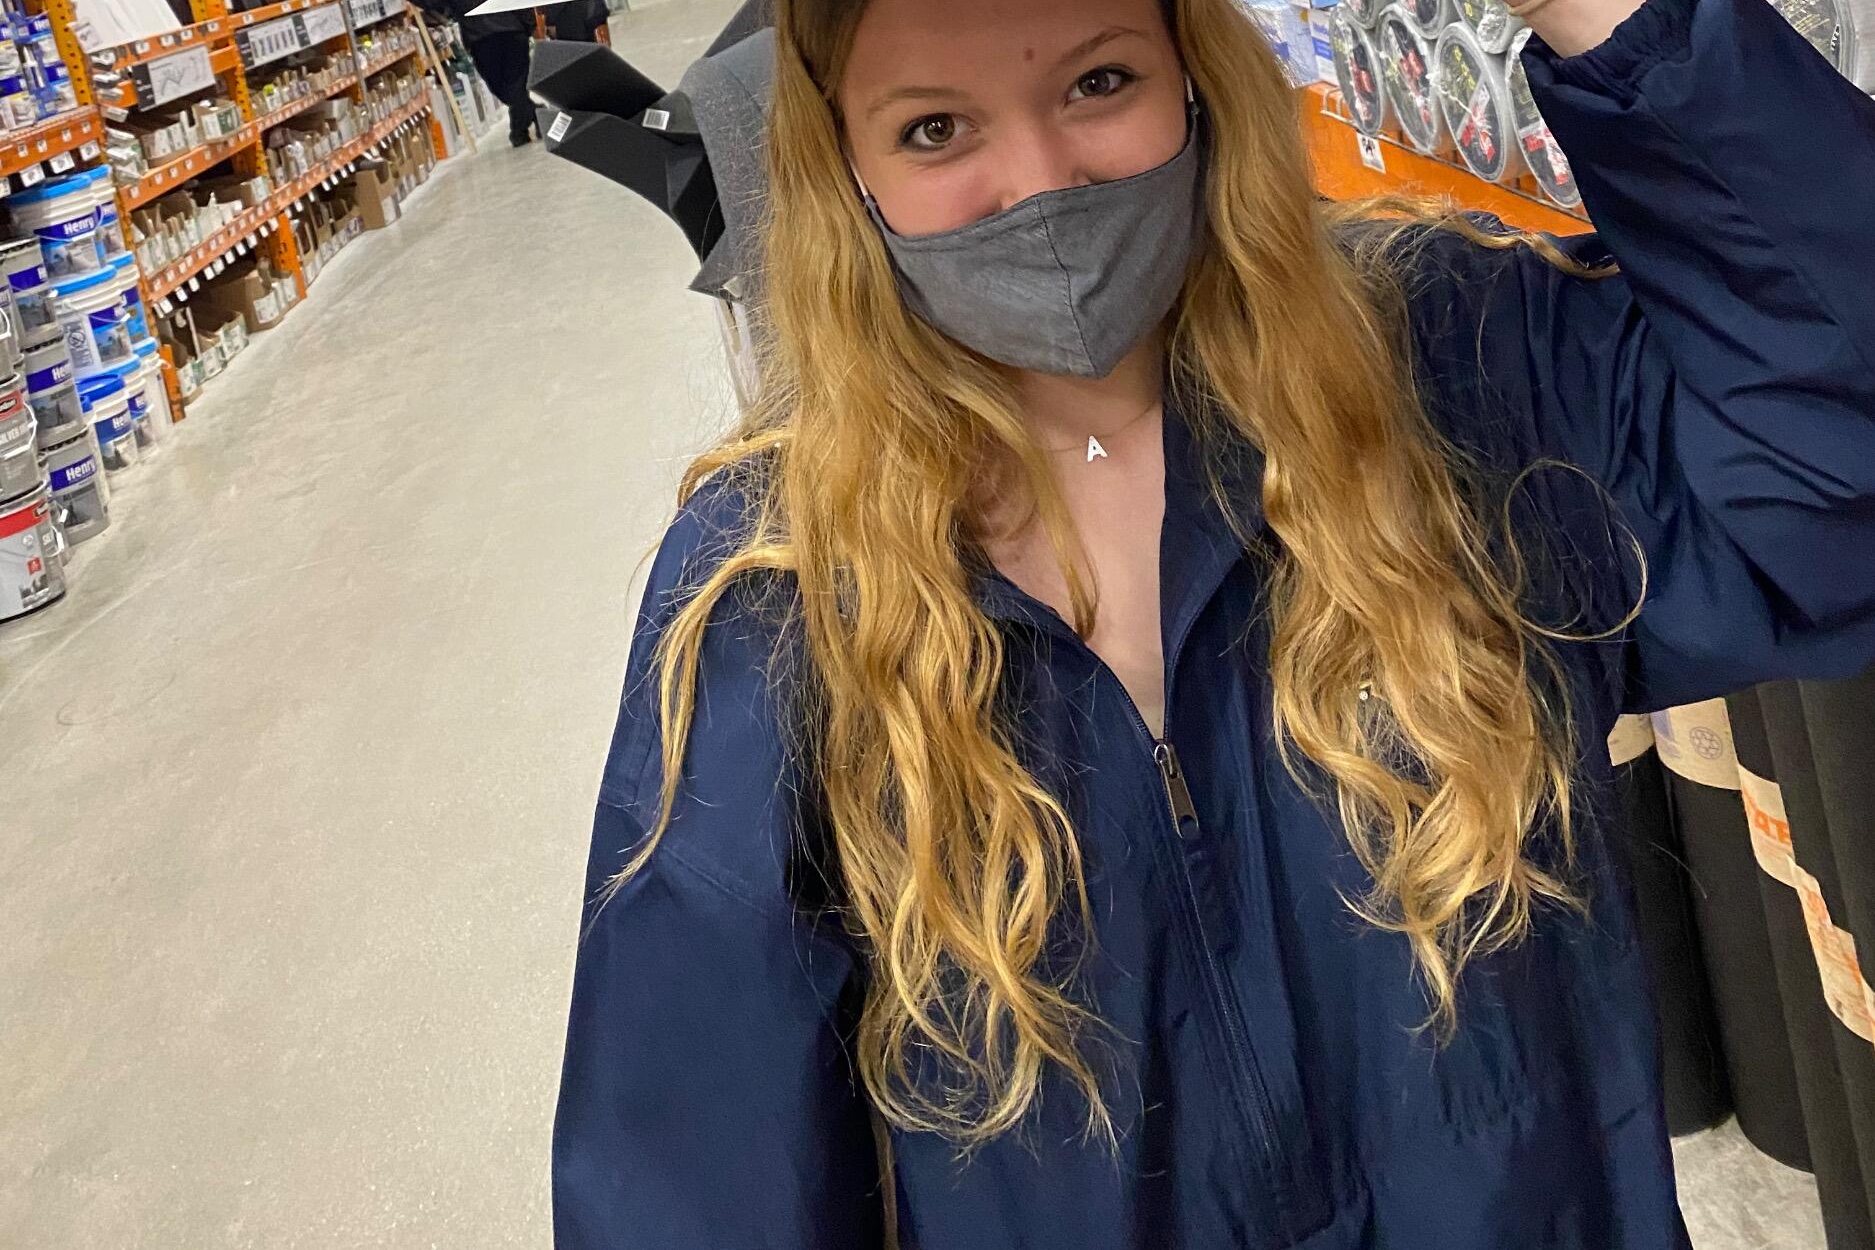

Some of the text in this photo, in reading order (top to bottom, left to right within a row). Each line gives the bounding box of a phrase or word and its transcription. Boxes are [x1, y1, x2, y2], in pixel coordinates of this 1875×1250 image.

[63, 216, 95, 236] Henry
[1087, 435, 1108, 462] A
[65, 459, 97, 482] Henry
